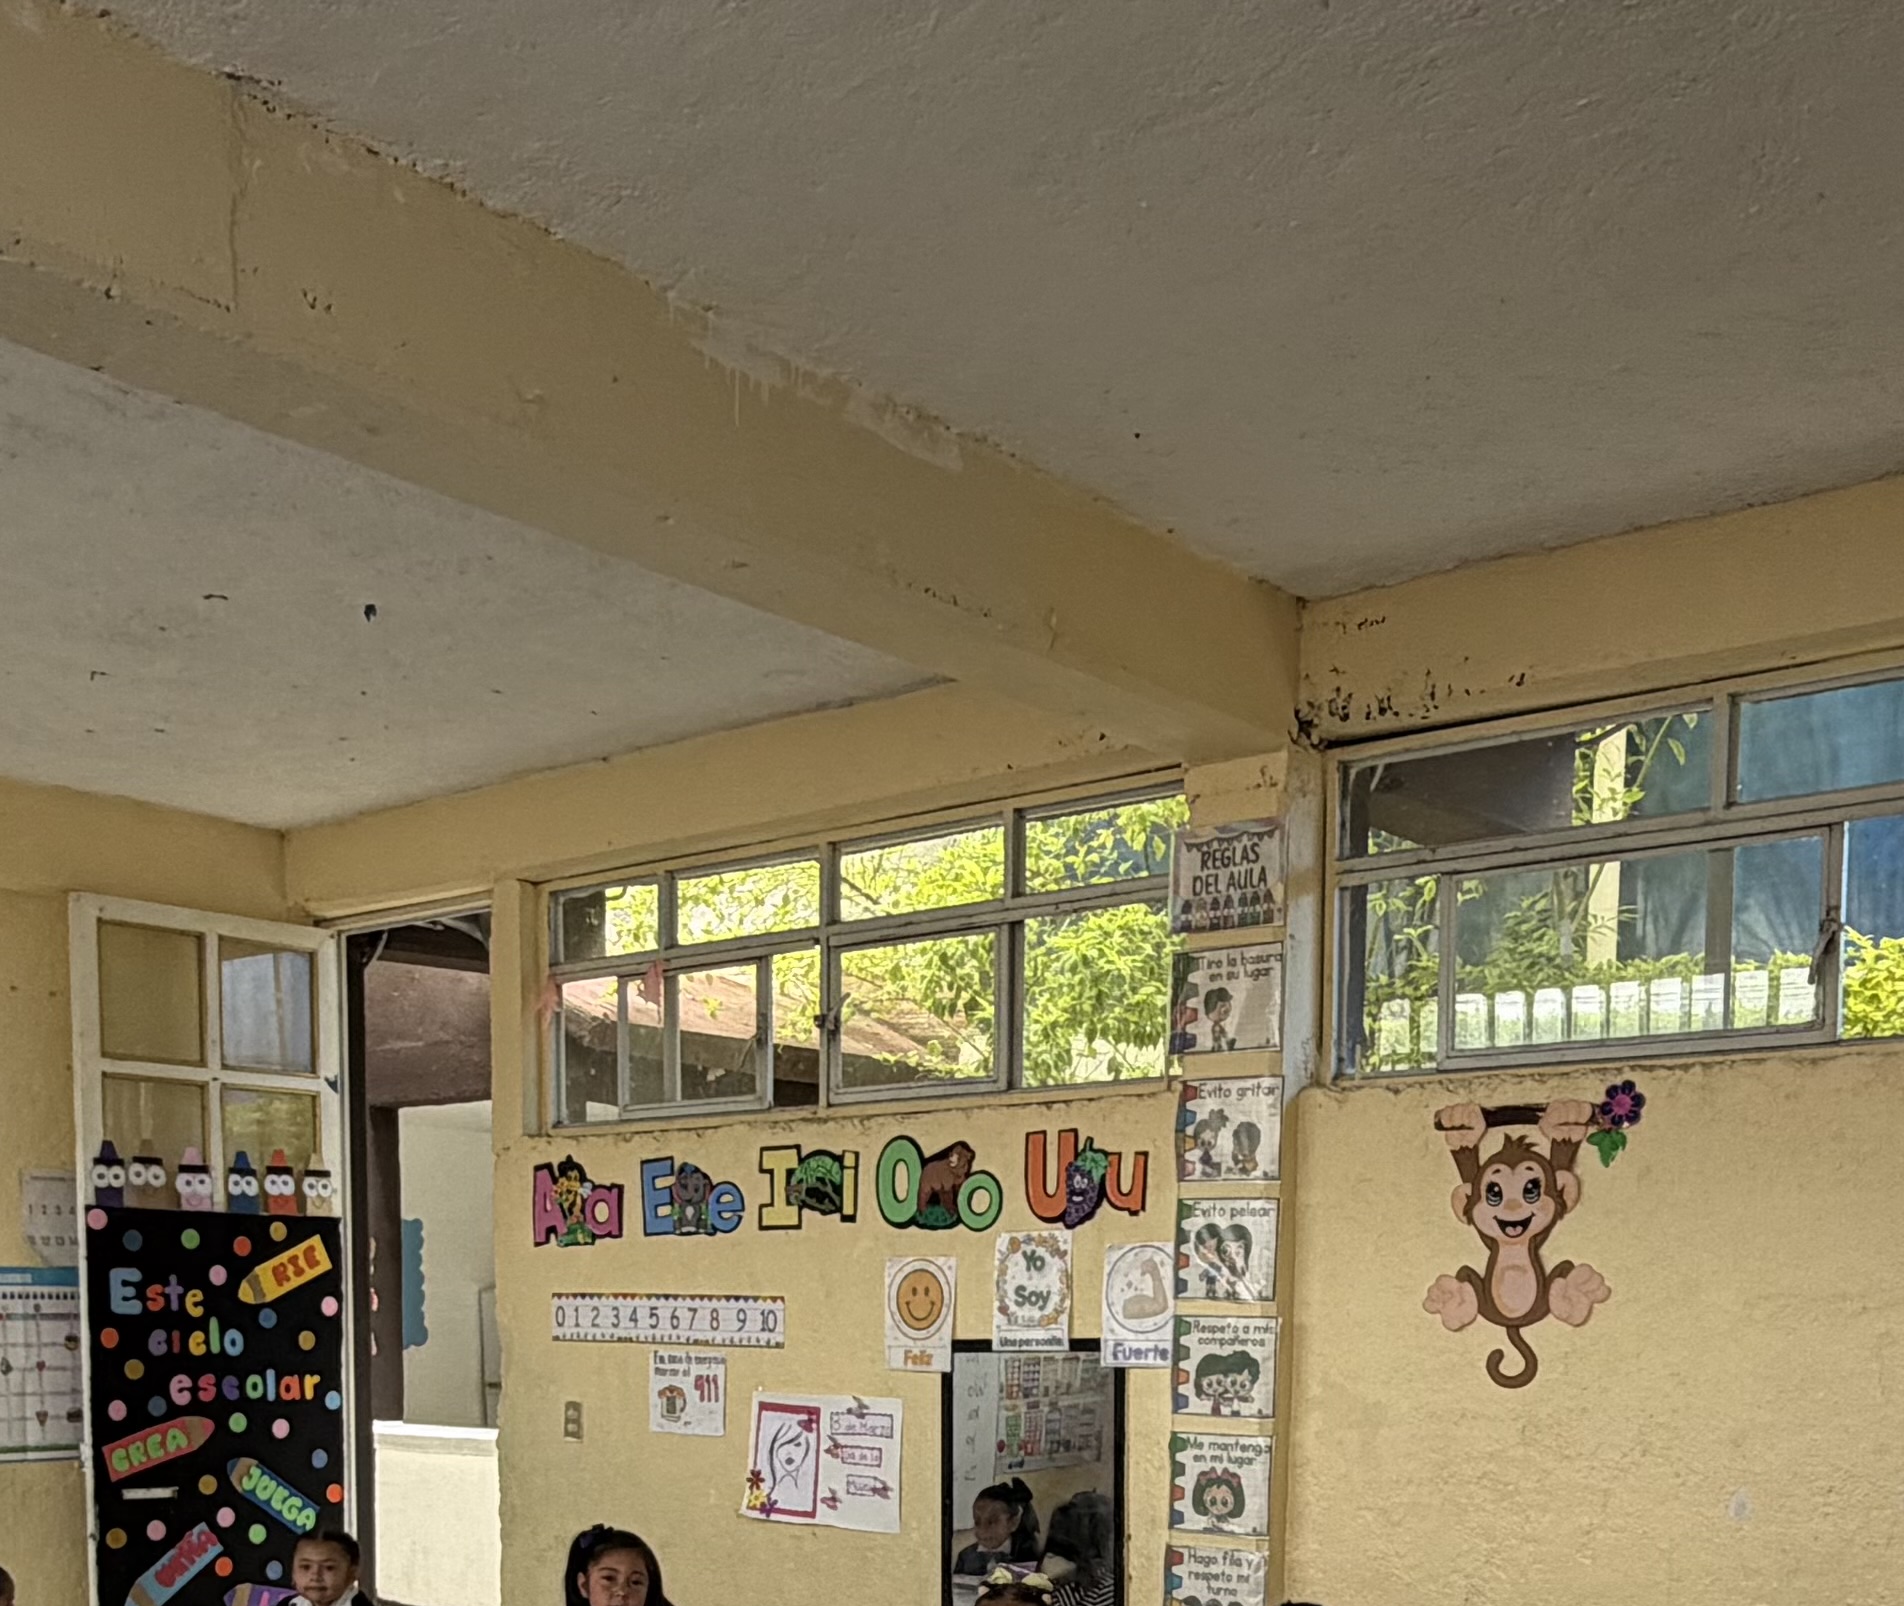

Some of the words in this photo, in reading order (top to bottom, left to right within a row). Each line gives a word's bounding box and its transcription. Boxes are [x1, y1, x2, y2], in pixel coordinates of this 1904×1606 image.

[1200, 842, 1260, 872] REGLAS
[1192, 873, 1222, 897] DEL
[1226, 865, 1268, 893] AULA
[1243, 965, 1275, 982] lugar
[1198, 1082, 1233, 1100] Evito
[1236, 1081, 1282, 1102] gritar
[1191, 1201, 1227, 1219] Evito
[272, 1243, 322, 1288] RIE
[1021, 1249, 1046, 1273] Yo
[109, 1267, 205, 1317] Este
[1013, 1284, 1052, 1311] Soy
[555, 1305, 566, 1328] 0
[573, 1306, 581, 1328] 1
[590, 1306, 601, 1328] 2
[611, 1306, 620, 1328] 3
[628, 1306, 639, 1328] 4
[648, 1307, 660, 1329] 5
[670, 1307, 680, 1330] 6
[687, 1307, 698, 1331] 7
[709, 1308, 720, 1331] 8
[736, 1308, 747, 1332] 9
[759, 1308, 778, 1333] 10
[147, 1316, 244, 1357] ciclo
[903, 1349, 934, 1367] Feliz
[1111, 1342, 1170, 1362] Fuerte
[169, 1367, 321, 1406] escolar
[110, 1427, 189, 1473] CREA
[242, 1464, 317, 1532] JUEGA
[1187, 1549, 1217, 1567] Hago
